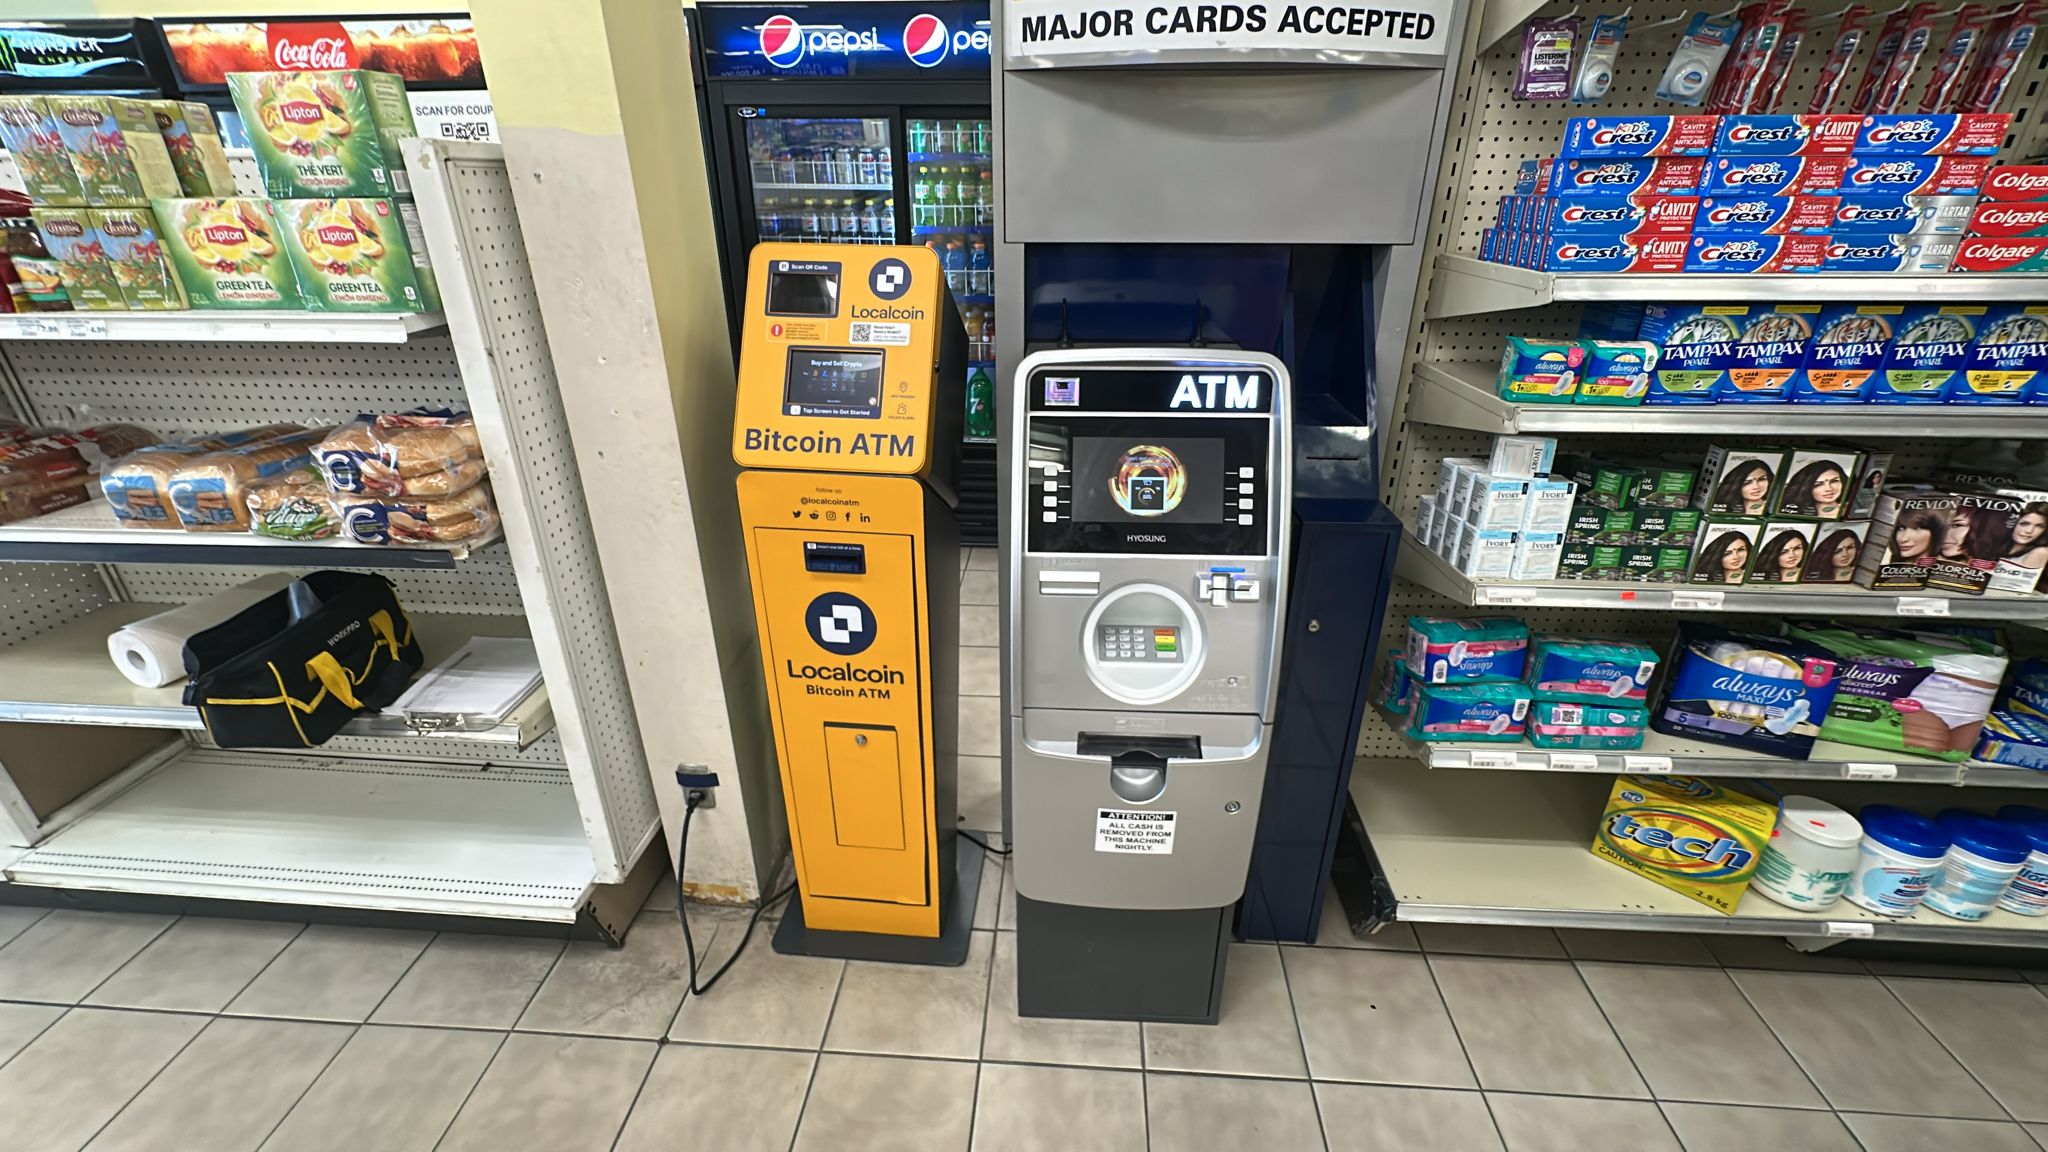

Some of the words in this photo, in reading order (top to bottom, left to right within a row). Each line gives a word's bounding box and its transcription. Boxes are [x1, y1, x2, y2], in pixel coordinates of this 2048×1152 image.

[1021, 9, 1134, 43] MAJOR
[1145, 5, 1267, 34] CARDS
[1277, 5, 1435, 41] ACCEPTED
[21, 37, 103, 55] MONSTER
[808, 27, 878, 55] pepsi
[37, 55, 94, 64] ENERGY
[285, 105, 321, 120] Lipton
[416, 106, 443, 116] SCAN
[445, 106, 464, 116] FOR
[1616, 121, 1649, 133] KID'S
[1824, 121, 1861, 136] CAVITY
[1895, 119, 1933, 131] KID'S
[1593, 128, 1656, 146] Crest
[1729, 125, 1792, 142] Crest
[1868, 127, 1940, 143] Crest
[298, 161, 317, 176] THÉ
[318, 165, 344, 176] VERT
[1600, 163, 1633, 174] KID'S
[1746, 162, 1780, 174] KID'S
[1877, 161, 1915, 173] KID'S
[1575, 170, 1639, 187] Crest
[1724, 169, 1787, 186] Crest
[1853, 167, 1922, 184] Crest
[1993, 173, 2048, 191] Colga
[1660, 202, 1697, 216] CAVITY
[1732, 201, 1767, 212] KID'S
[1838, 205, 1903, 221] Crest
[1563, 206, 1627, 223] Crest
[1709, 208, 1774, 224] Crest
[208, 229, 244, 241] Lipton
[321, 230, 355, 243] Lipton
[1557, 244, 1620, 260] Crest
[1652, 241, 1688, 254] CAVITY
[1722, 240, 1759, 251] KID'S
[1826, 244, 1889, 260] Crest
[1965, 244, 2035, 261] Colgate
[1699, 248, 1765, 263] Crest
[216, 281, 251, 291] GREEN
[252, 281, 273, 291] TEA
[329, 282, 361, 292] GREEN
[363, 283, 382, 292] TEA
[245, 292, 278, 300] GINSENG
[356, 294, 388, 302] GINSENG
[851, 305, 924, 320] Localcoin
[1664, 343, 1732, 361] TAMPAX
[1735, 341, 1804, 359] TAMPAX
[1815, 342, 1884, 360] TAMPAX
[1894, 342, 1967, 361] TAMPAX
[1976, 343, 2048, 361] TAMPAX
[1535, 362, 1566, 374] always
[1609, 362, 1641, 374] always
[1169, 375, 1259, 409] ATM
[745, 428, 842, 454] Bitcoin
[850, 434, 914, 457] ATM
[1531, 448, 1542, 471] IVORY
[801, 497, 860, 506] @localcoinatm
[1905, 500, 1959, 510] REVLON
[1962, 497, 2024, 513] EVLON
[1127, 535, 1167, 543] HYOSUNG
[1934, 563, 1986, 578] OLORSILK
[327, 620, 361, 647] WORKPRO
[787, 659, 905, 685] Localcoin
[1582, 666, 1622, 678] always
[806, 684, 854, 697] Bitcoin
[858, 688, 891, 699] ATM
[1712, 674, 1799, 705] always
[1736, 693, 1764, 704] MAXI
[1463, 706, 1501, 718] always
[1836, 704, 1872, 713] MAXIMUM
[1677, 712, 1688, 723] 5
[1108, 812, 1166, 821] ATTENTION!
[1608, 813, 1752, 869] tech
[1696, 890, 1713, 902] 2.8
[1715, 897, 1729, 909] kg
